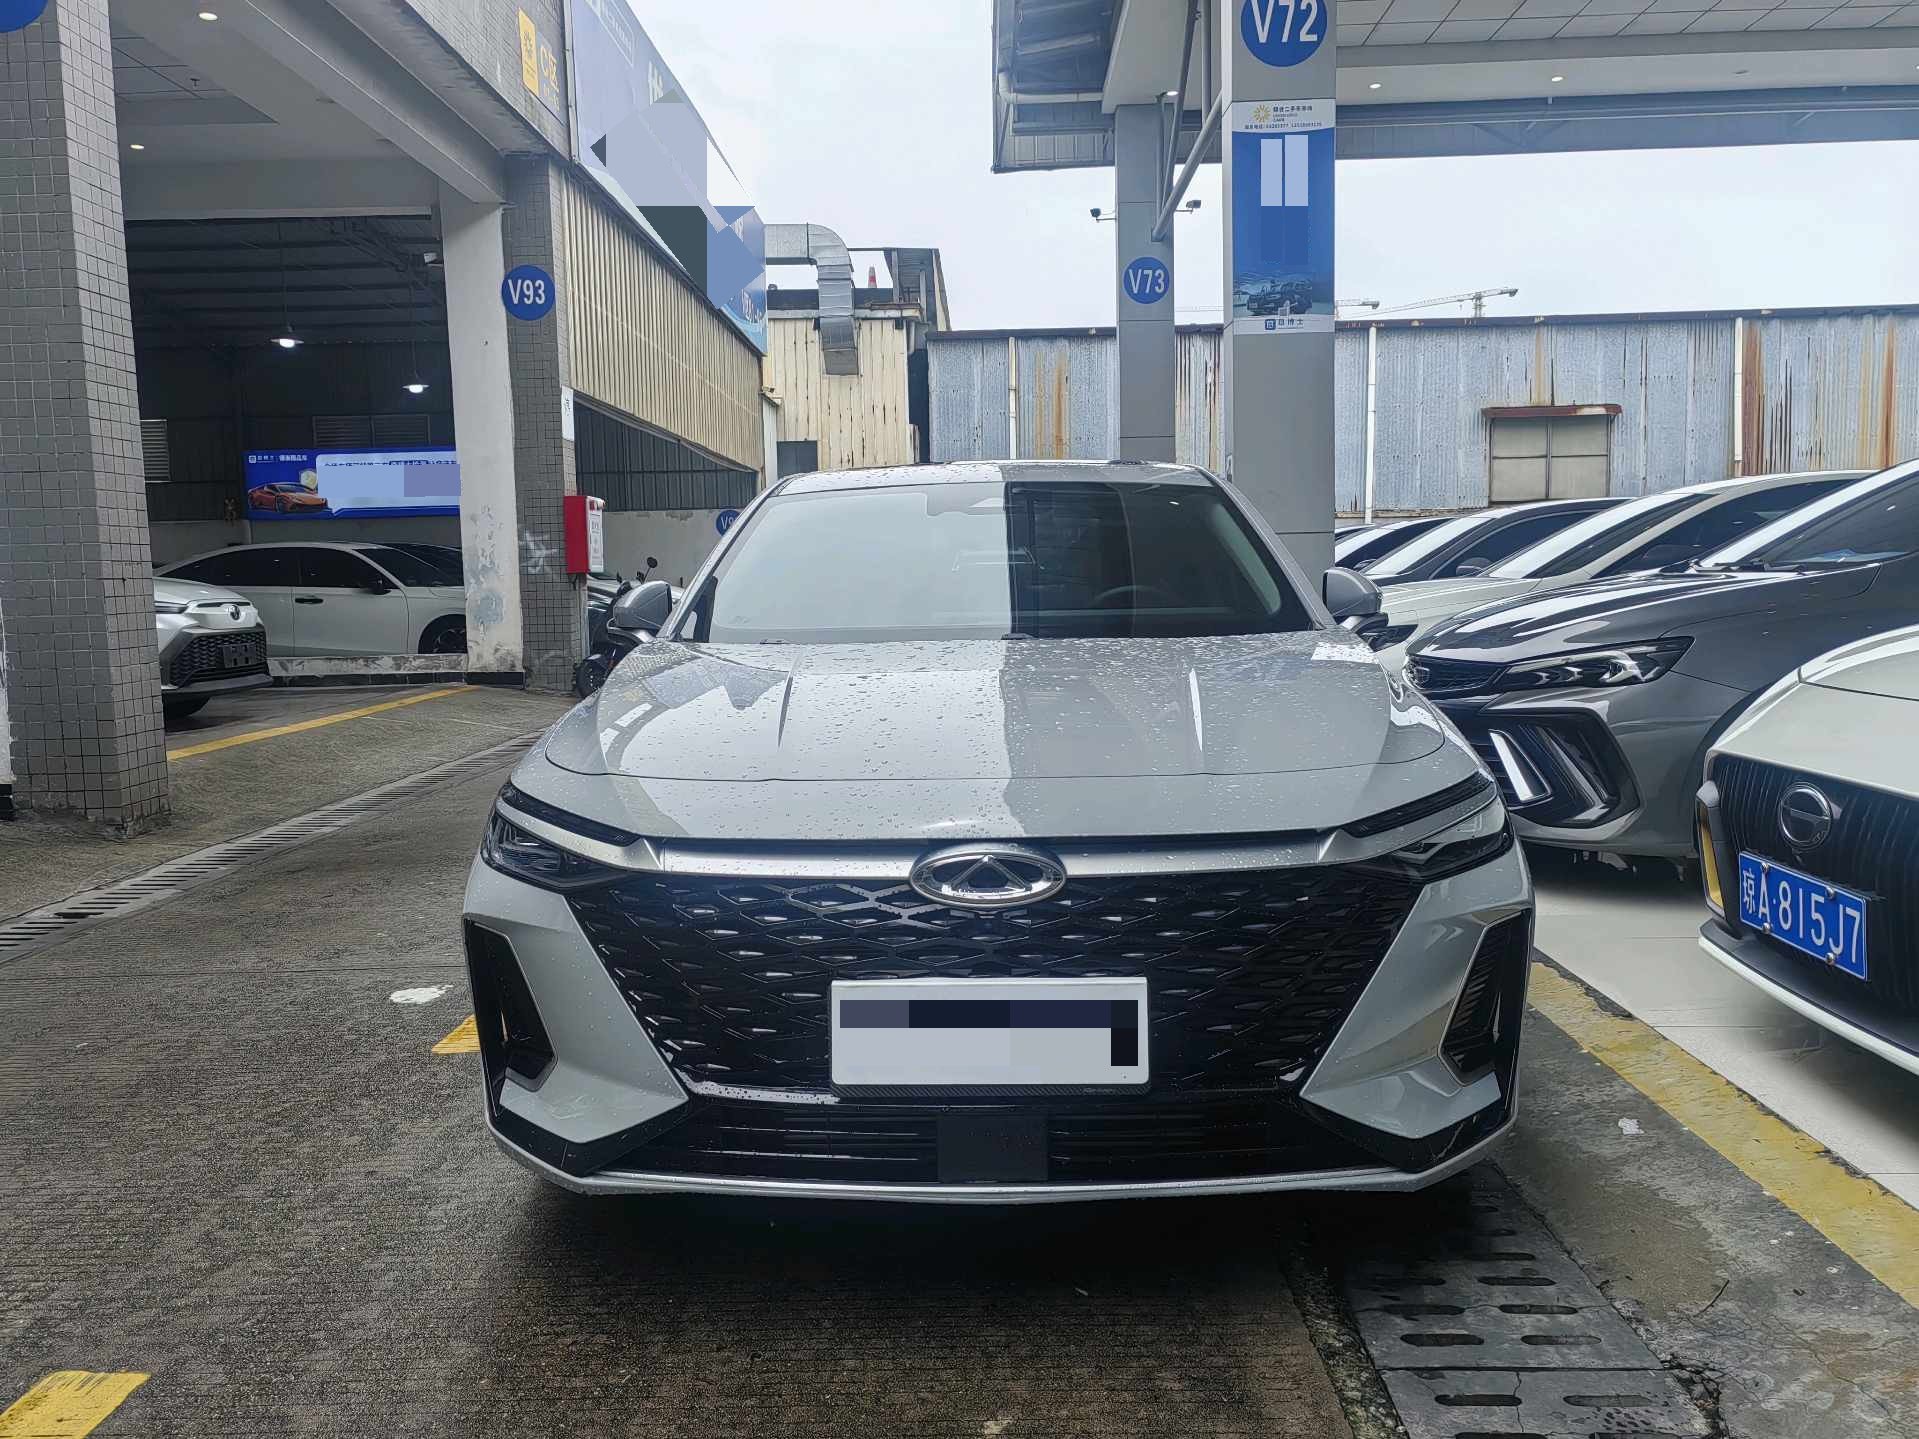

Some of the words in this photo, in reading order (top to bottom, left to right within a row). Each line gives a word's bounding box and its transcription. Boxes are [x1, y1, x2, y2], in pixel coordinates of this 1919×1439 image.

[1250, 0, 1318, 43] V72
[507, 279, 546, 305] V93
[1128, 268, 1165, 294] V73
